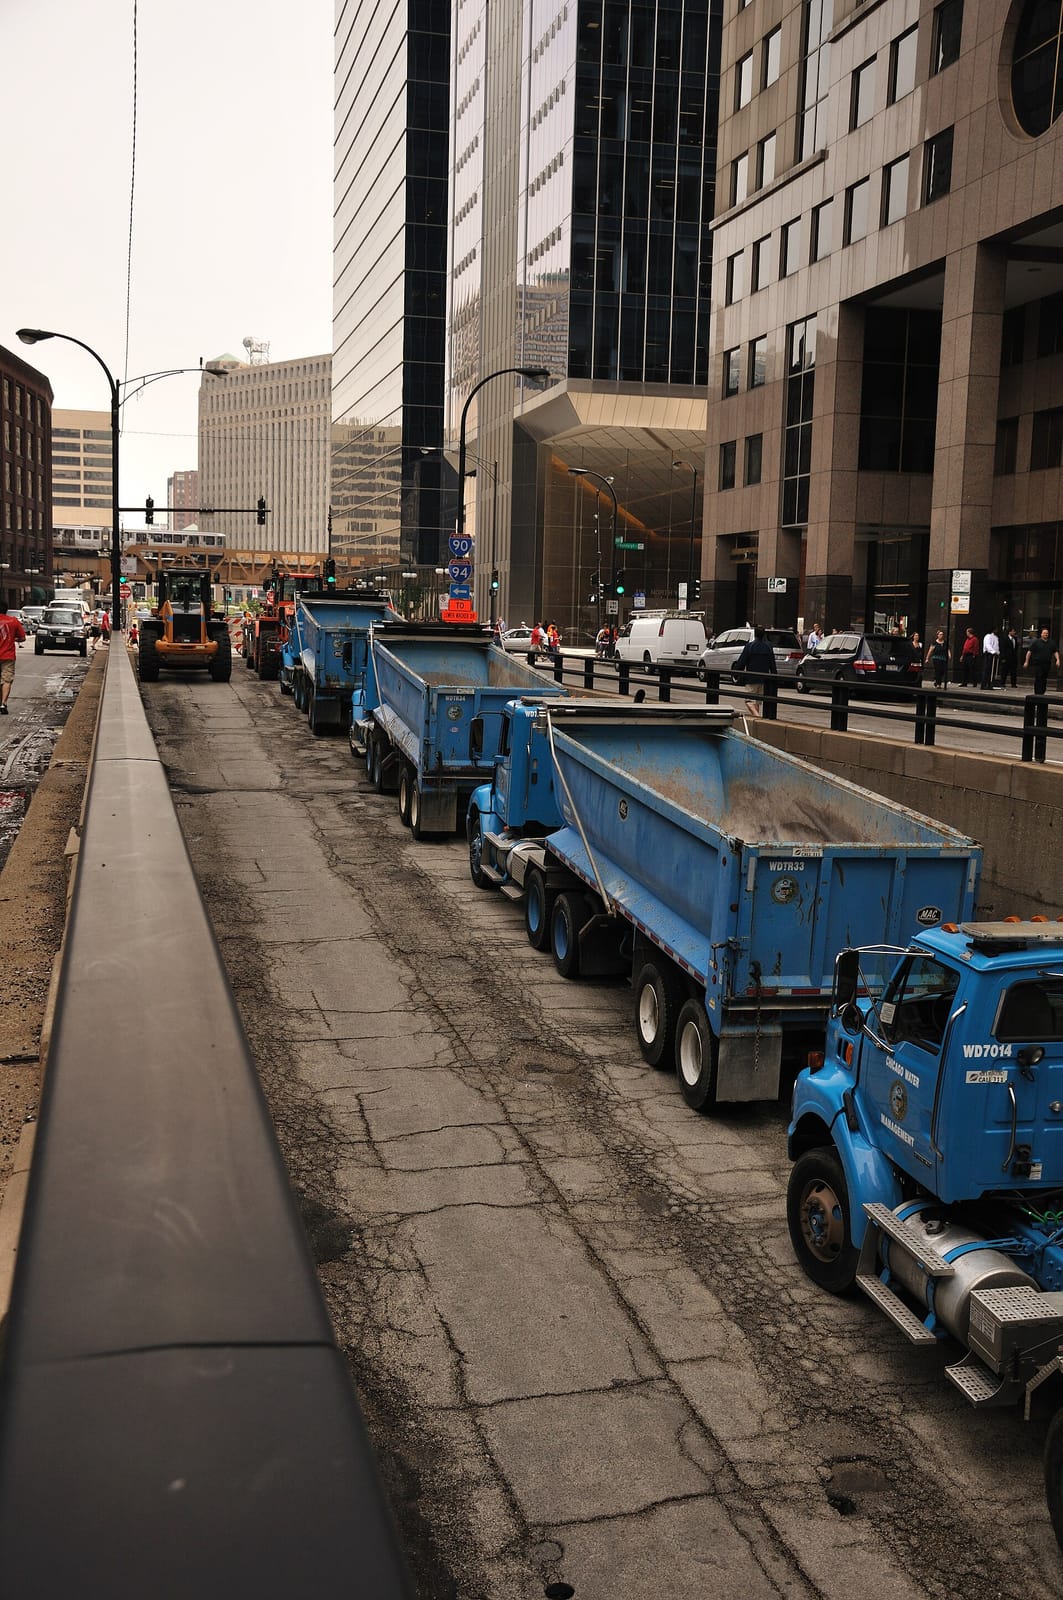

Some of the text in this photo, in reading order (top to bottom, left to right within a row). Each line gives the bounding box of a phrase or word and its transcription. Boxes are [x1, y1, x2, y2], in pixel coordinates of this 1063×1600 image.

[452, 540, 468, 552] 90
[452, 566, 468, 578] 94
[770, 861, 805, 871] WDTR33
[920, 909, 938, 918] MAC
[962, 1044, 1012, 1058] WD7014
[885, 1055, 920, 1088] CHICAGO WATER
[880, 1112, 914, 1148] MANAGEMENT
